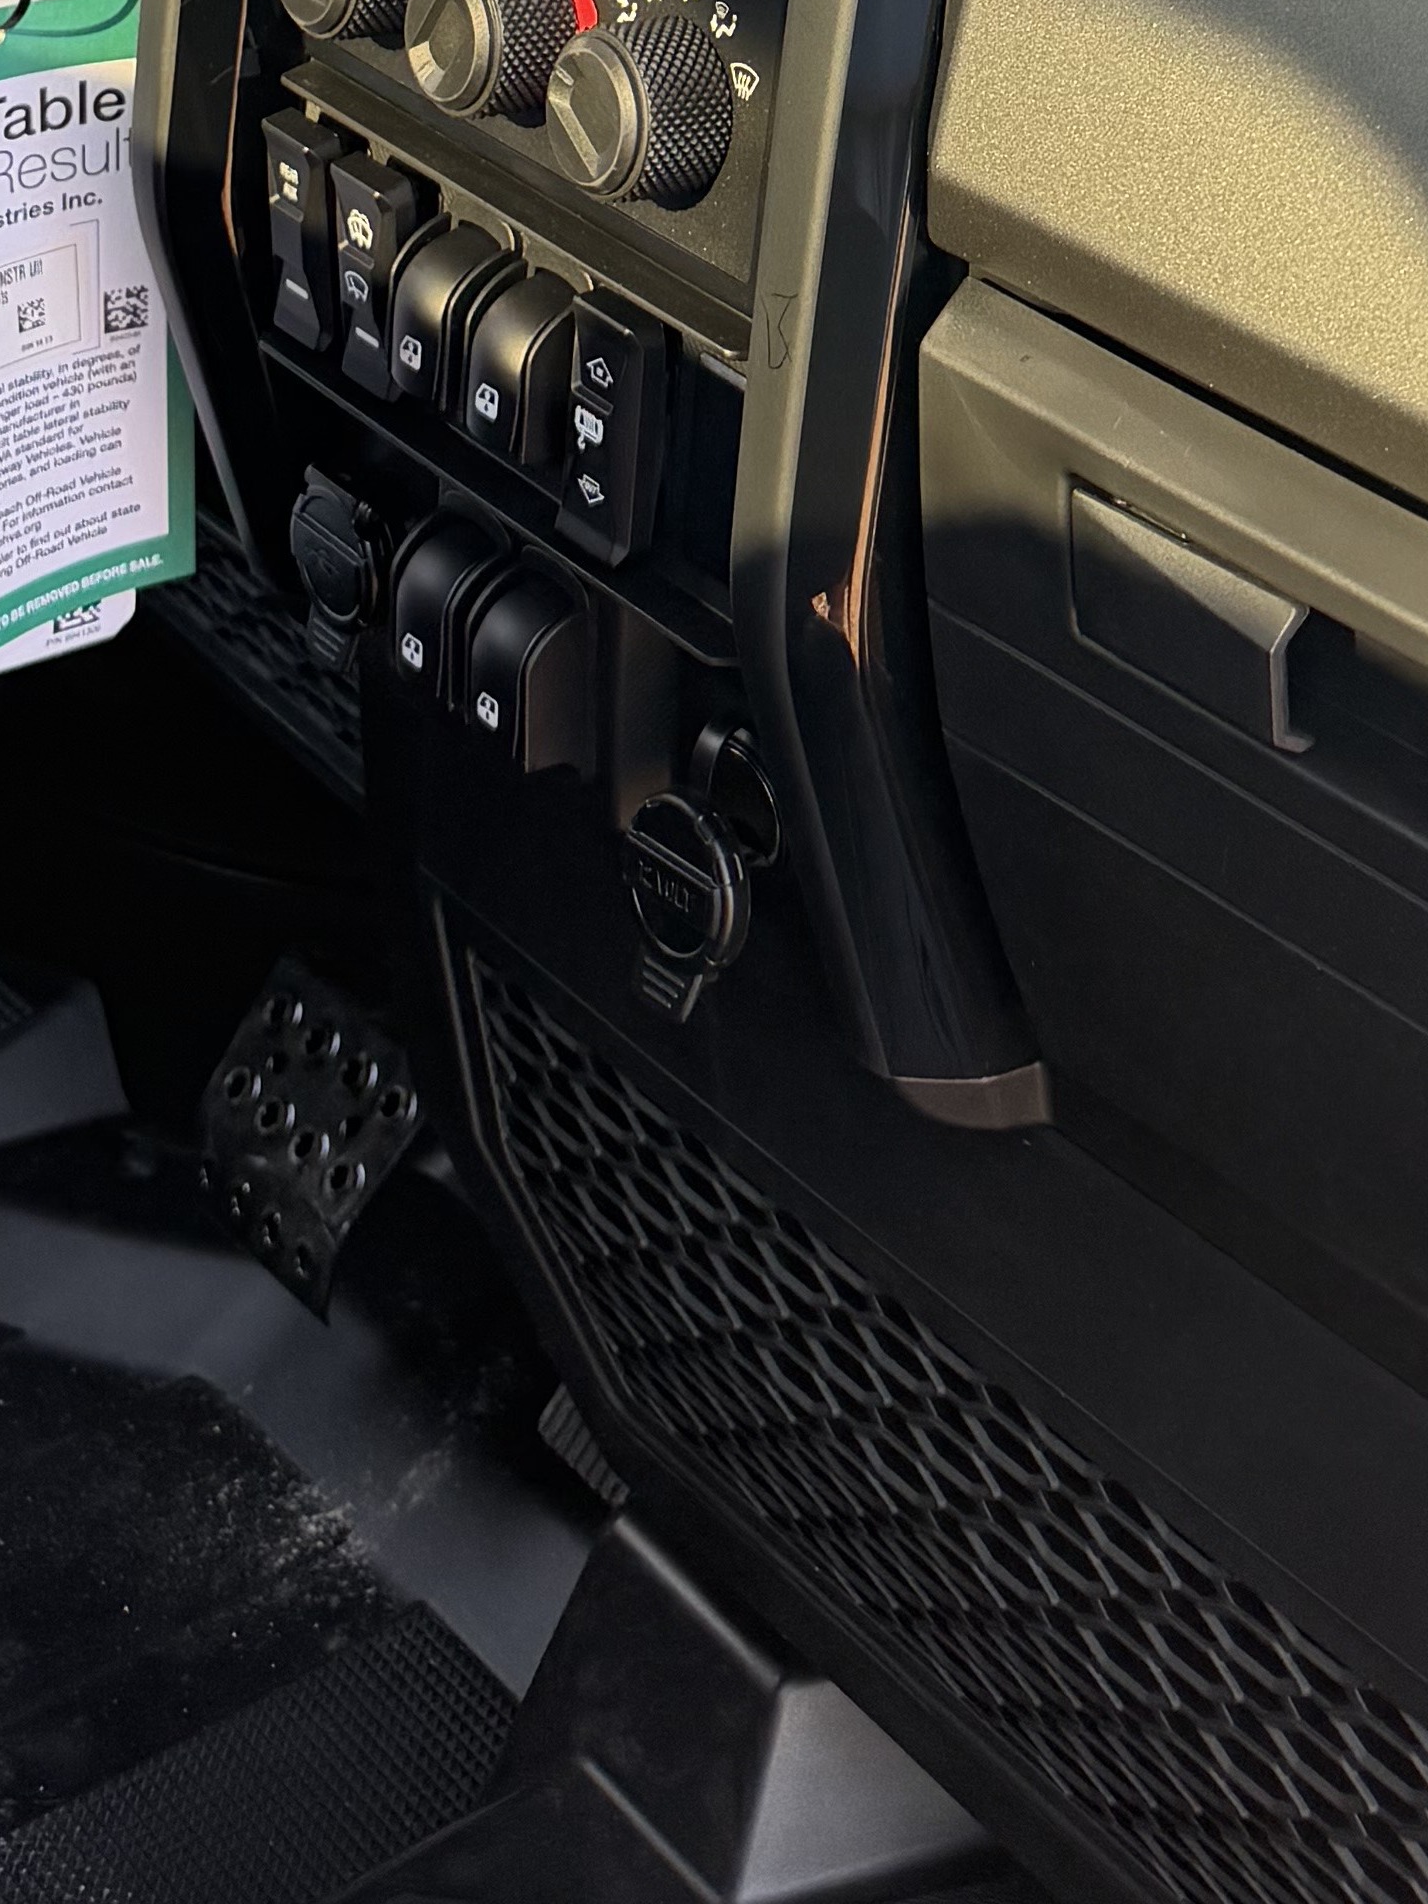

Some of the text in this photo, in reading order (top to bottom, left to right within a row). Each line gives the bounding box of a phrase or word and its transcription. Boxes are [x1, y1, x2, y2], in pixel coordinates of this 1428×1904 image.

[62, 191, 104, 213] Inc.
[127, 343, 140, 356] of
[24, 394, 49, 411] load
[87, 371, 136, 392] pounds)
[42, 372, 84, 390] vehicle
[87, 363, 116, 380] (with
[119, 359, 135, 370] an
[12, 425, 40, 442] table
[43, 411, 79, 430] lateral
[83, 399, 129, 418] stability
[69, 399, 80, 409] in
[14, 429, 64, 455] standard
[67, 424, 83, 436] for
[79, 427, 121, 444] Vehicle
[29, 460, 50, 477] and
[53, 447, 96, 466] loading
[99, 439, 122, 452] can
[1, 516, 18, 531] For
[22, 491, 85, 521] information
[88, 475, 132, 495] contact
[25, 479, 76, 506] Off-Road
[79, 467, 121, 485] Vehicle
[15, 540, 64, 568] Off-Road
[67, 526, 107, 545] Vehicle
[16, 544, 27, 555] to
[29, 532, 50, 548] find
[53, 524, 71, 539] out
[74, 511, 107, 531] about
[111, 504, 140, 518] state
[11, 605, 26, 623] BE
[26, 580, 79, 614] REMOVED
[81, 563, 128, 588] BEFORE
